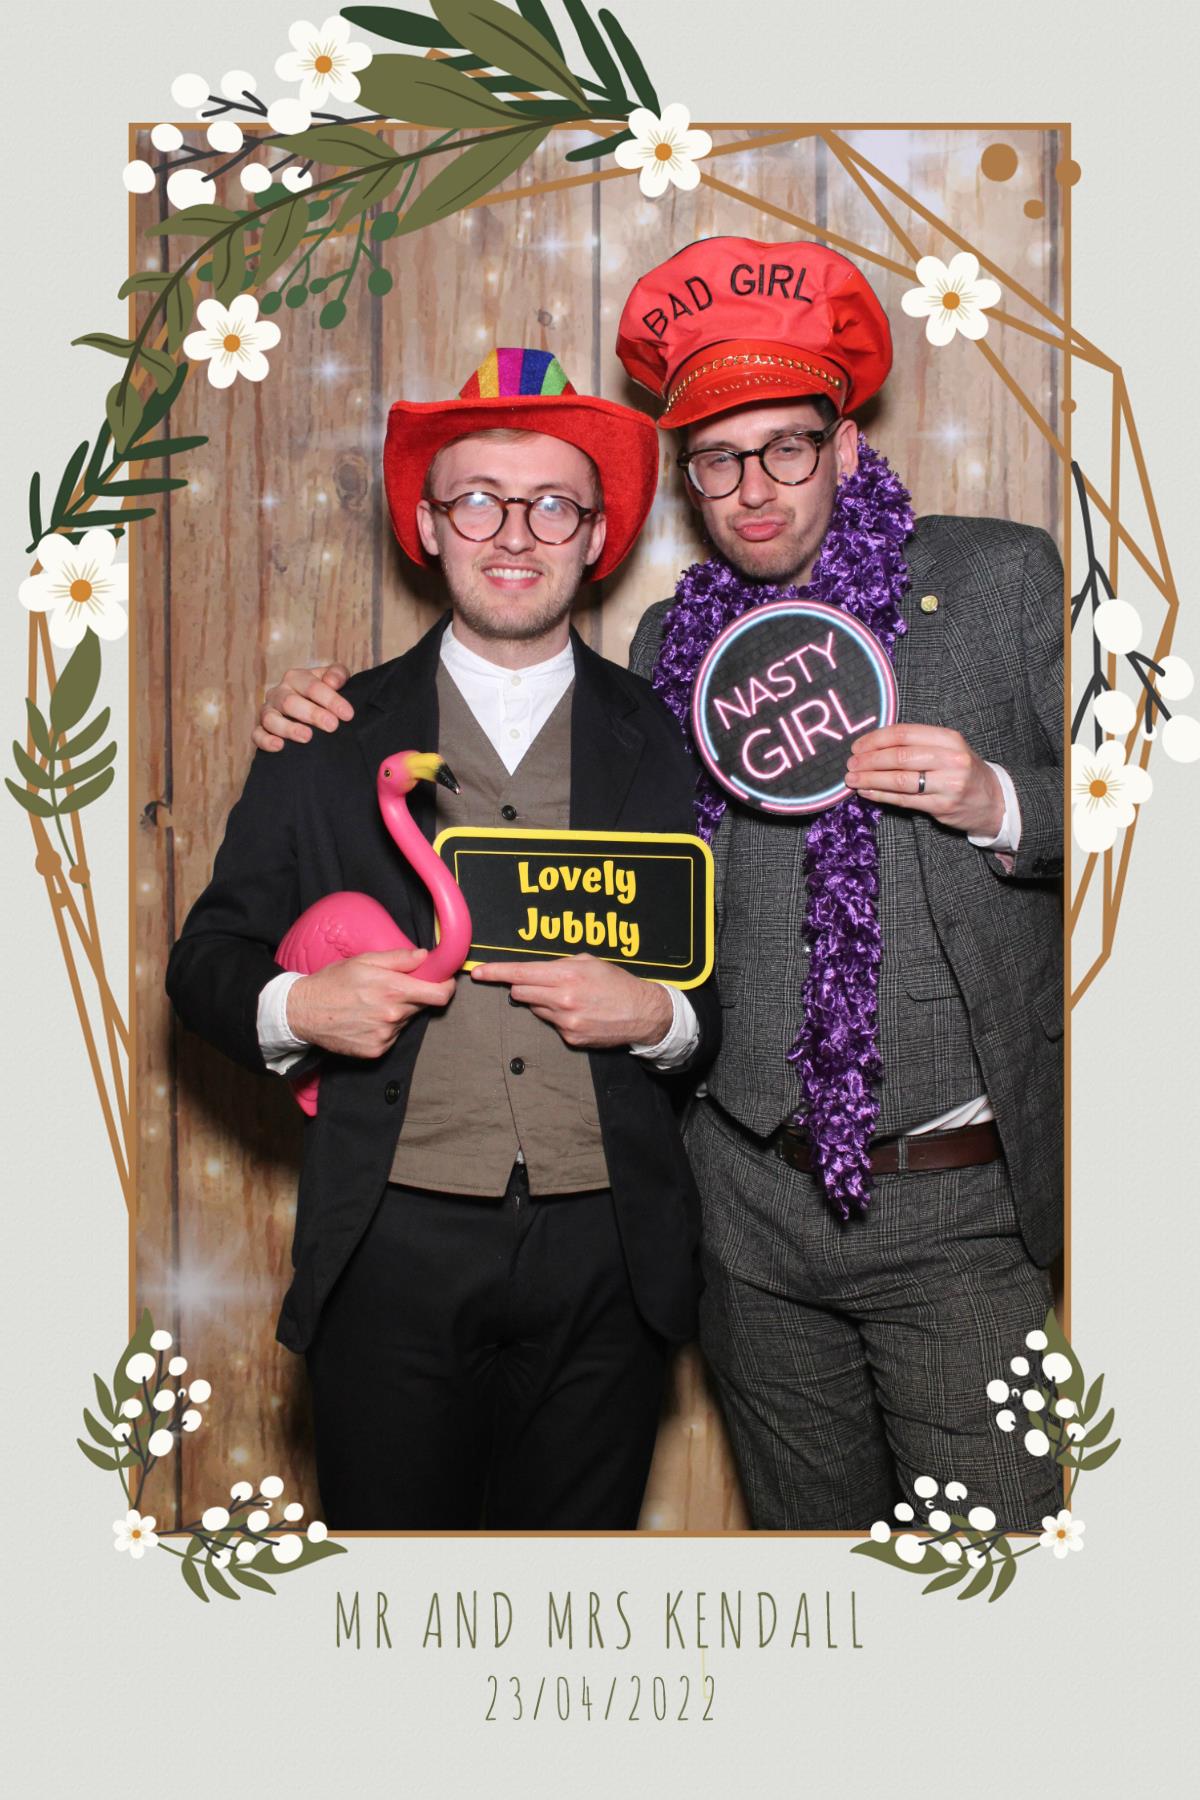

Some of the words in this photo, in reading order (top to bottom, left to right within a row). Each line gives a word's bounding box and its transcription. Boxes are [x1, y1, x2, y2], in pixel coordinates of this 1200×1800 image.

[642, 275, 714, 340] BAD
[730, 263, 813, 304] GIRL
[713, 631, 837, 730] NASTY
[741, 688, 877, 780] GIRL
[518, 860, 637, 905] Lovely
[518, 907, 640, 957] Jubbly
